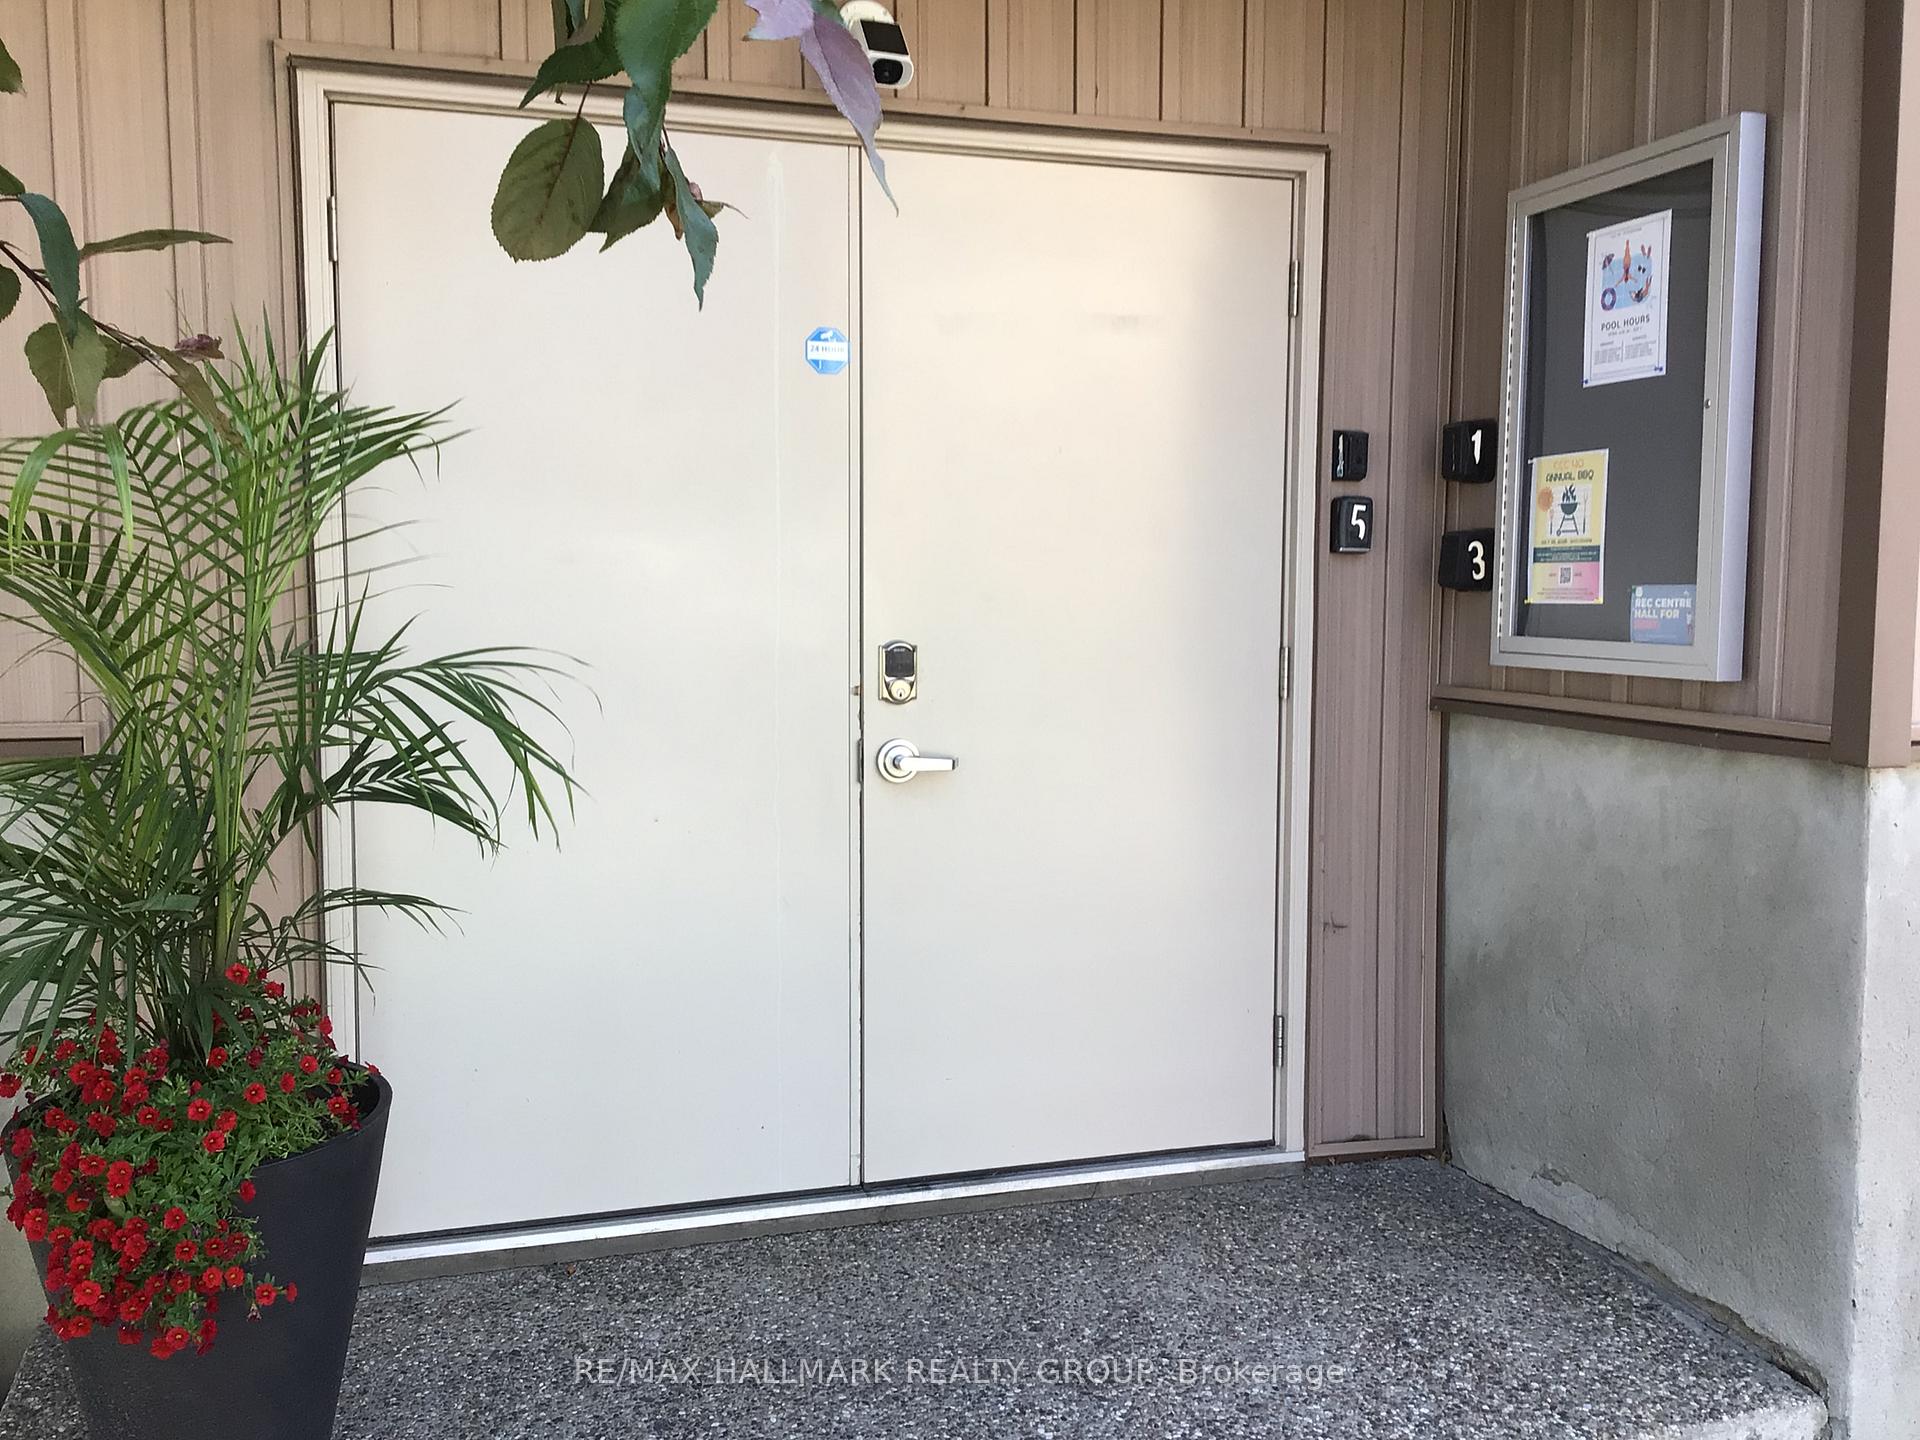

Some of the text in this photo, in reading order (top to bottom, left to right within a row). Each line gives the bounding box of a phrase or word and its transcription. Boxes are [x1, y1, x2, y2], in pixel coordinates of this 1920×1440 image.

[1601, 320, 1620, 332] POOL
[1623, 314, 1650, 327] HOURS
[1471, 429, 1482, 465] 1
[1350, 504, 1367, 541] 5
[1467, 540, 1486, 581] 3
[1634, 609, 1680, 619] HALL FOR
[1635, 597, 1692, 609] REC CENTRE
